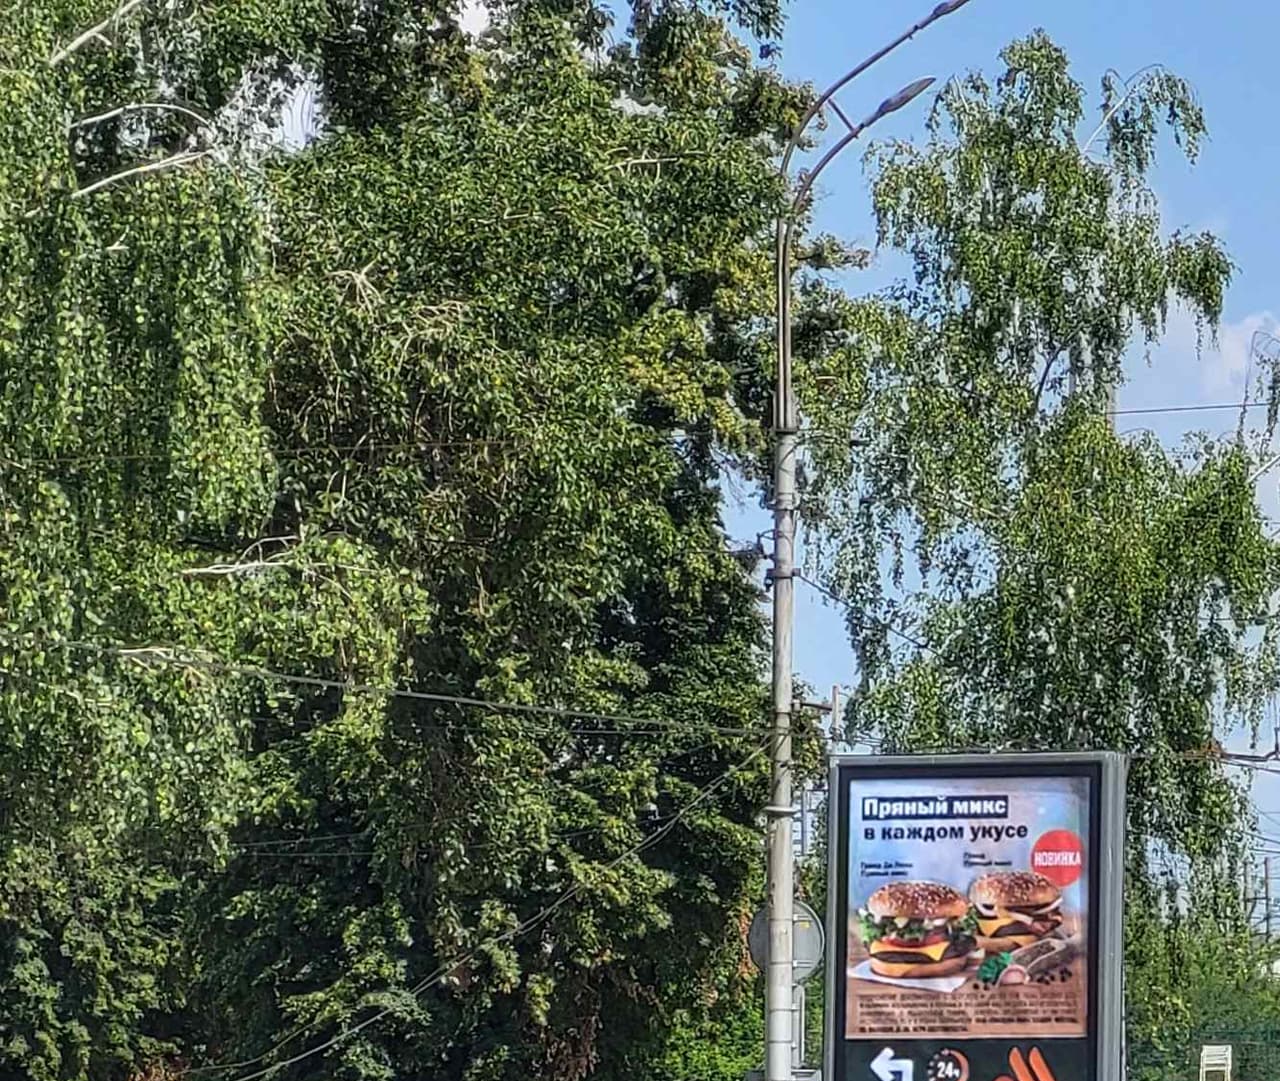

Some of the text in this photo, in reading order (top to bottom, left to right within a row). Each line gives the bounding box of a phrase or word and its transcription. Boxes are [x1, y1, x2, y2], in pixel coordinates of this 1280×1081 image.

[863, 796, 1006, 818] Пряный микс
[864, 824, 1028, 842] в каждом укусе
[1034, 851, 1081, 867] НОВИНКА
